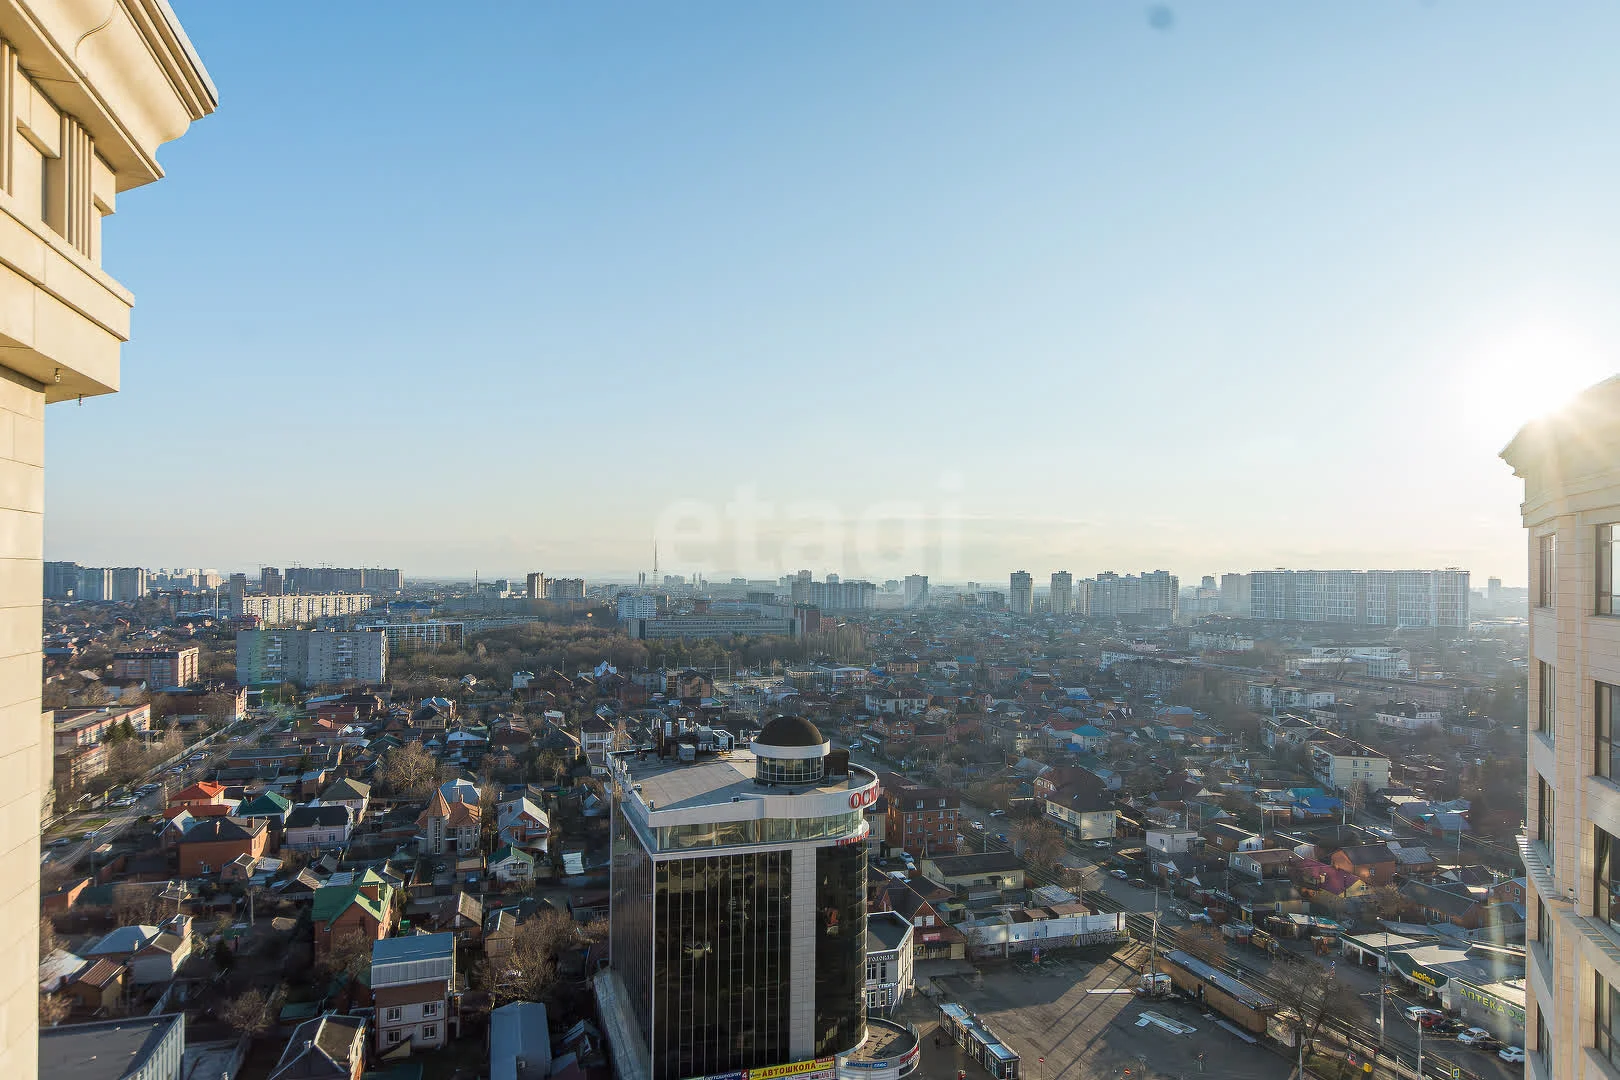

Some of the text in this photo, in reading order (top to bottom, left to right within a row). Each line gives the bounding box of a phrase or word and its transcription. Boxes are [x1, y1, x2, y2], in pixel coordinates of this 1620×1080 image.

[1412, 970, 1436, 985] МОЙКА
[1460, 988, 1505, 1013] АПТЕКА
[762, 1062, 816, 1077] АВТОШКОЛА
